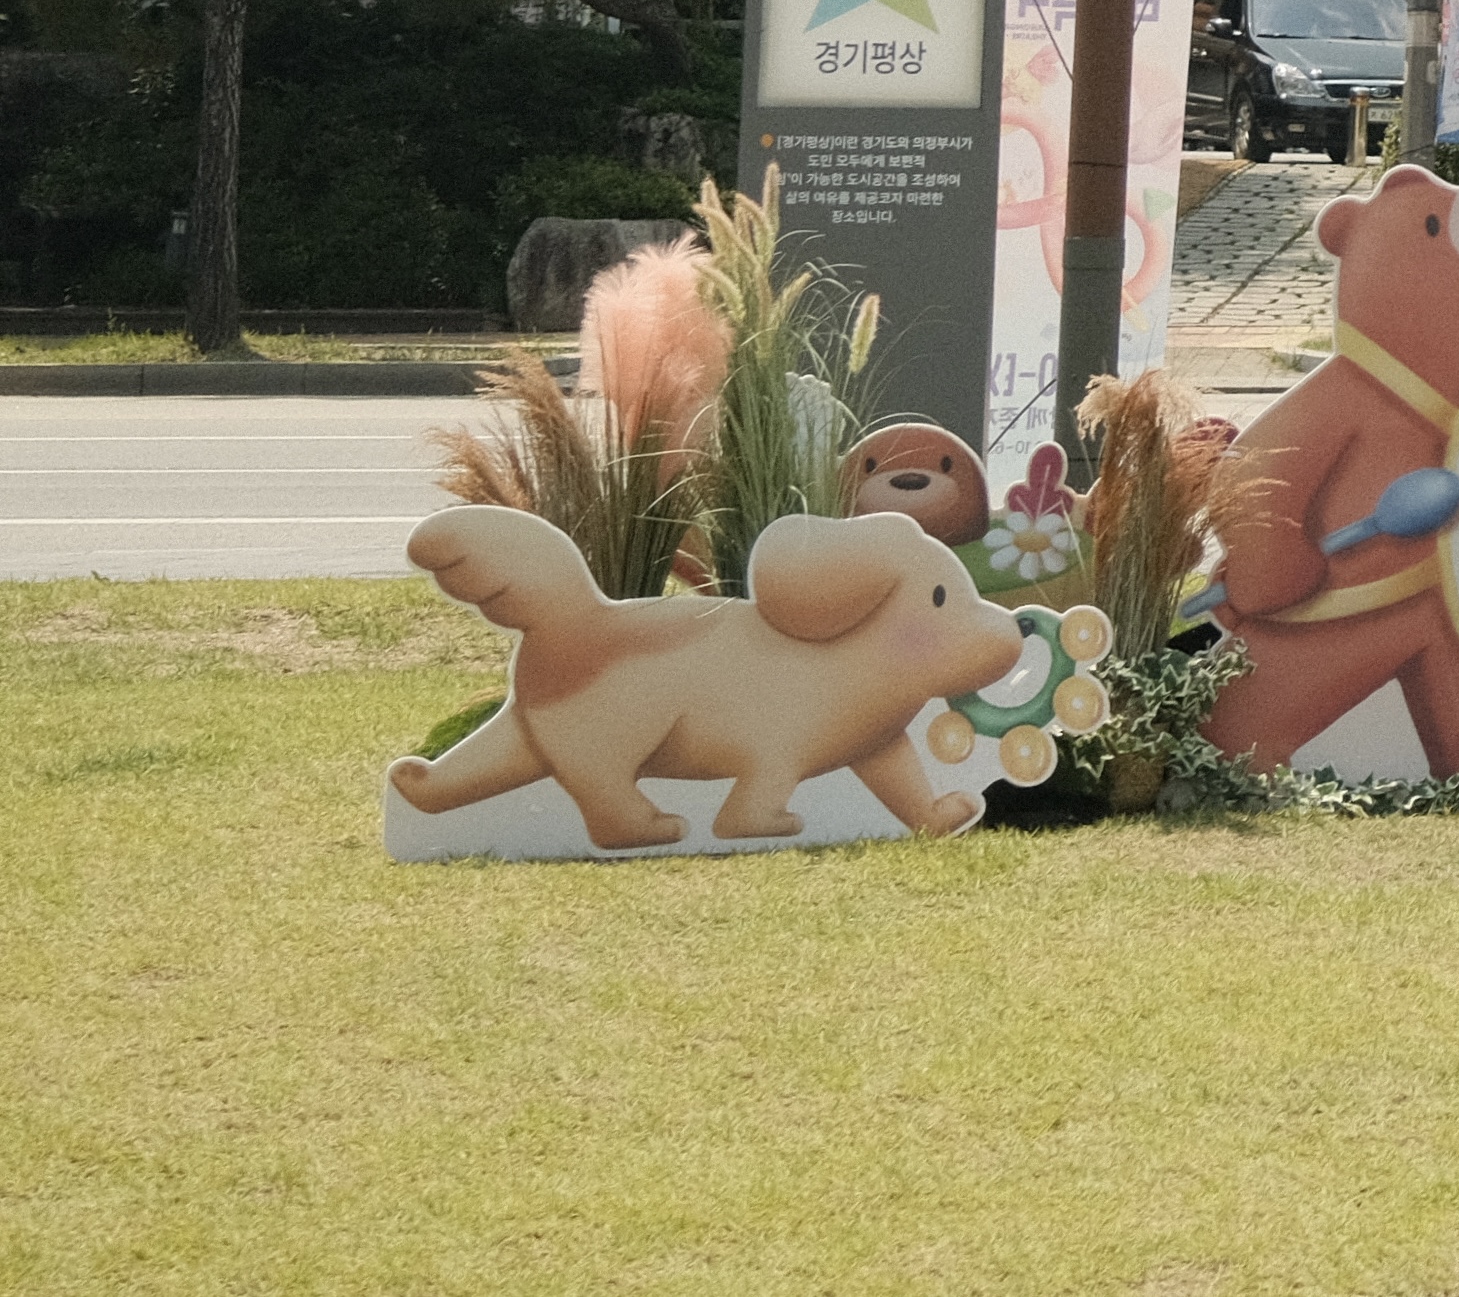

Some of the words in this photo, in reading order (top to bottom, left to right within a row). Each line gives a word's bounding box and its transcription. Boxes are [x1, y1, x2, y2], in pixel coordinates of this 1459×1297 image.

[814, 40, 927, 74] 경기평상
[807, 154, 833, 167] 도민
[835, 154, 885, 167] 모두에게
[806, 172, 845, 186] 가능한
[906, 191, 944, 206] 마련한
